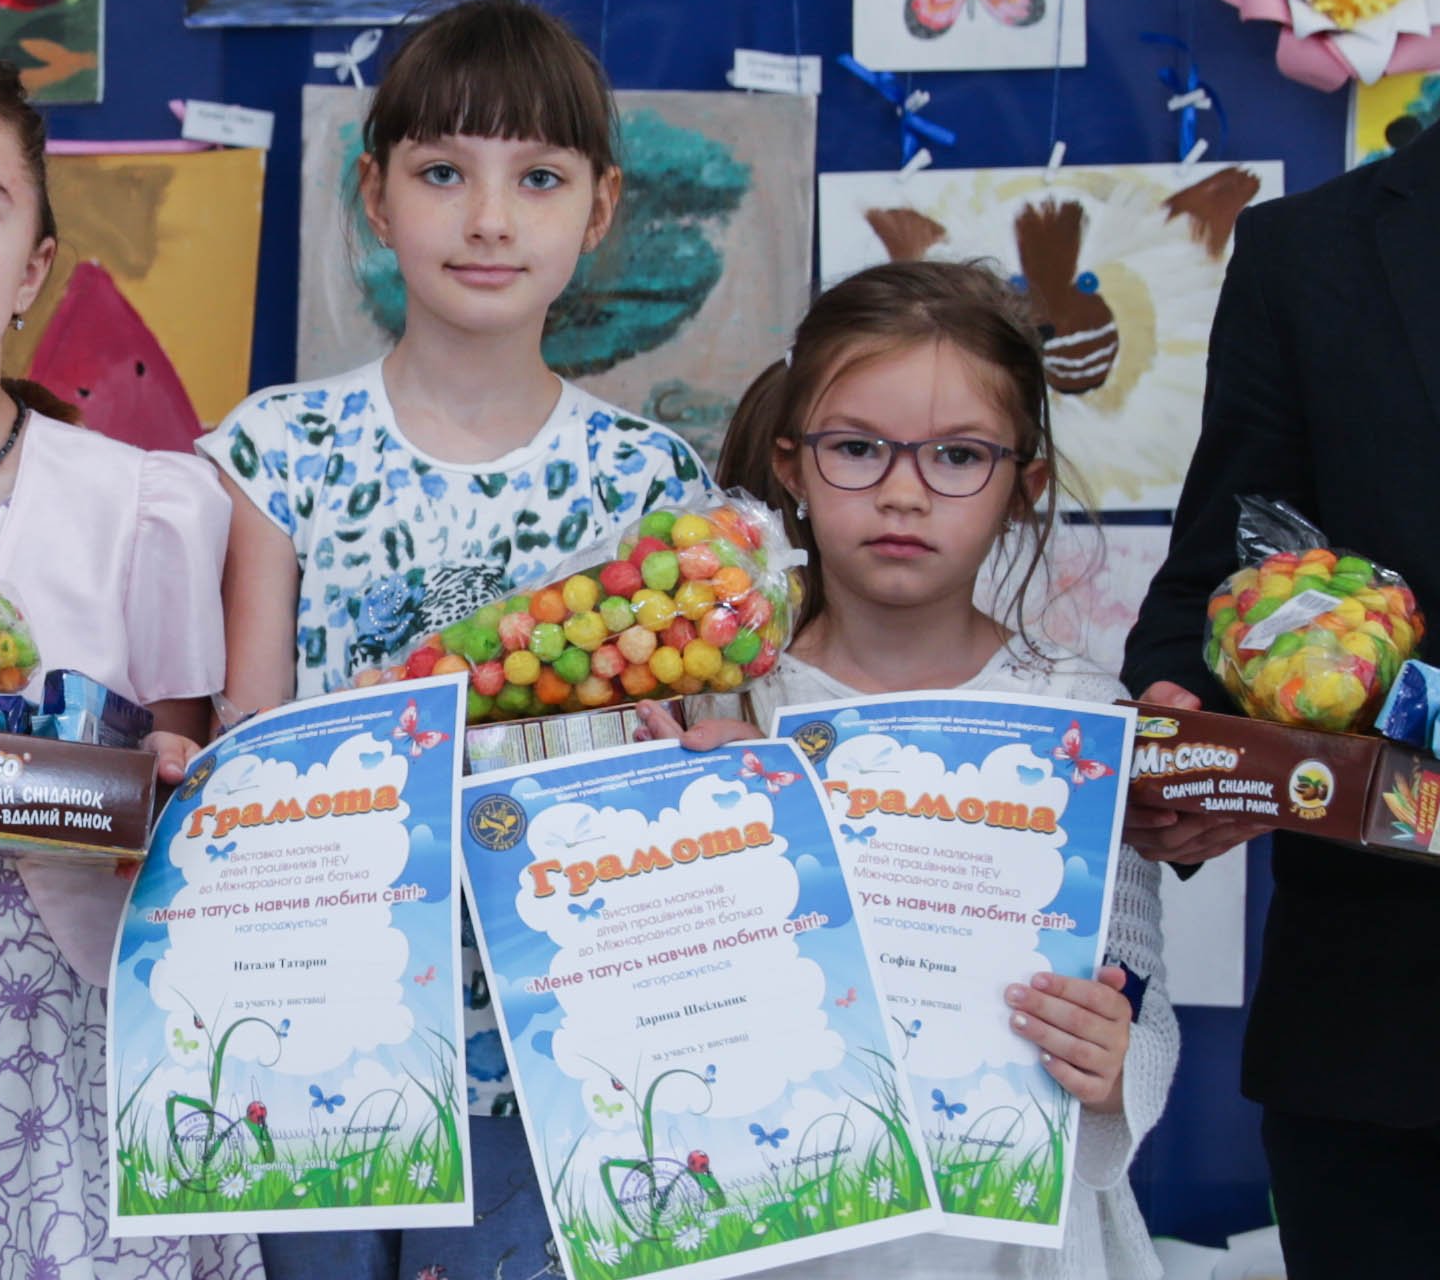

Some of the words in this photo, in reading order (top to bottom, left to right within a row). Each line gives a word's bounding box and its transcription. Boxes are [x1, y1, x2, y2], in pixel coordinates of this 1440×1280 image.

[22, 784, 105, 811] СНІДАНОК
[1162, 778, 1215, 800] СМАЧНИЙ
[1218, 779, 1275, 798] СНІДАНОК
[64, 810, 113, 833] РАНОК
[186, 784, 400, 839] Грамота
[1245, 798, 1280, 816] РАНОК
[527, 820, 774, 898] Грамота
[147, 907, 196, 923] «Мене
[201, 904, 250, 921] татусь
[255, 898, 310, 913] навчив
[315, 889, 377, 907] любити
[382, 885, 427, 902] світ!»
[896, 896, 956, 915] навчив
[961, 903, 1026, 925] любити
[1031, 912, 1077, 929] світ!»
[526, 969, 583, 994] «Мене
[587, 958, 643, 982] татусь
[647, 943, 708, 966] навчив
[712, 926, 779, 952] любити
[783, 911, 828, 935] світ!»
[635, 1008, 681, 1030] Дарина
[683, 994, 747, 1017] Шкільник
